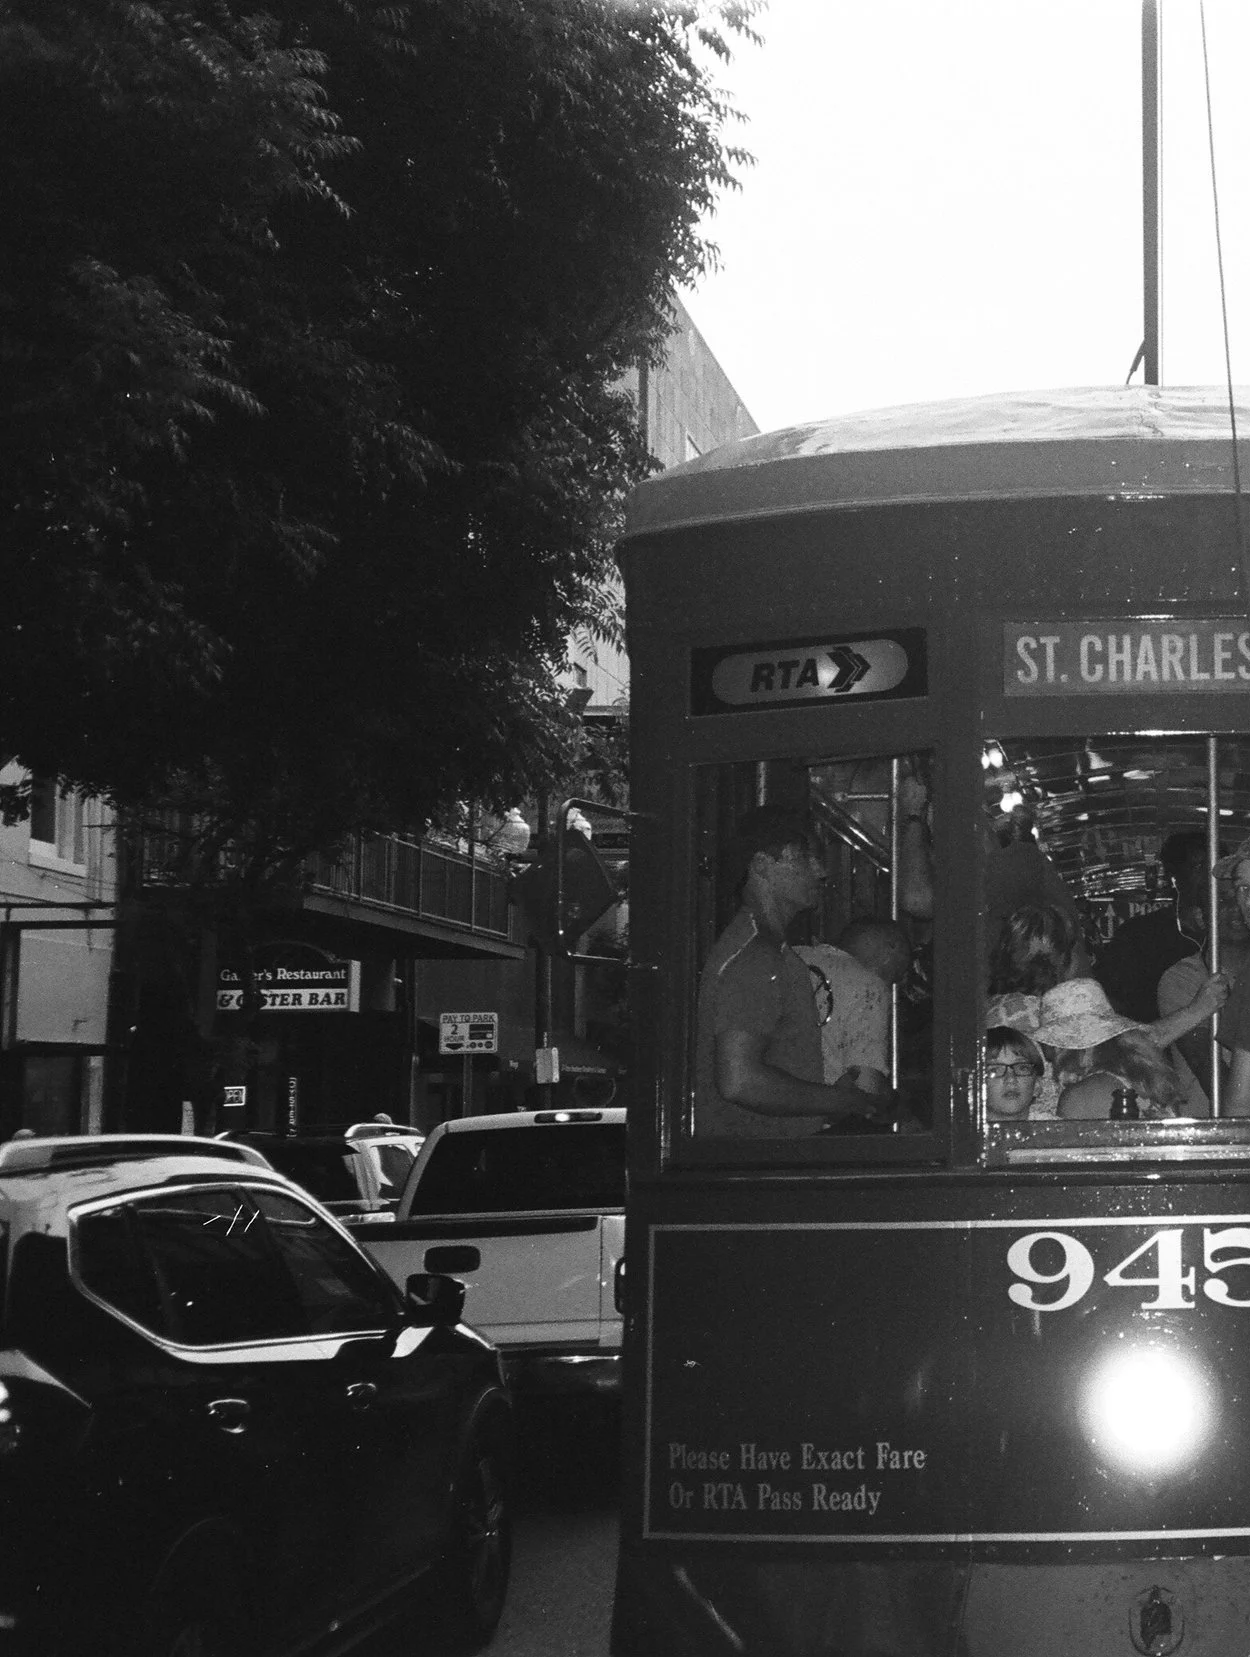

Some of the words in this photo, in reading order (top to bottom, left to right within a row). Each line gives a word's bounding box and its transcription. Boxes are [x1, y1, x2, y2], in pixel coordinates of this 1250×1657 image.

[1017, 635, 1069, 684] ST.
[749, 658, 820, 693] RTA
[219, 968, 273, 982] Gaer's
[276, 967, 347, 981] Restaurant
[236, 992, 303, 1007] OSTER
[307, 992, 346, 1007] BAR
[442, 1014, 458, 1023] PAY
[459, 1014, 471, 1023] TO
[472, 1014, 495, 1023] PARK
[450, 1023, 458, 1035] 2
[668, 1442, 731, 1470] Please
[739, 1442, 792, 1470] Have
[800, 1442, 866, 1470] Exact
[876, 1441, 928, 1470] Fare
[668, 1481, 695, 1510] Or
[702, 1482, 749, 1511] RTA
[757, 1482, 803, 1511] Pass
[811, 1482, 882, 1516] Ready
